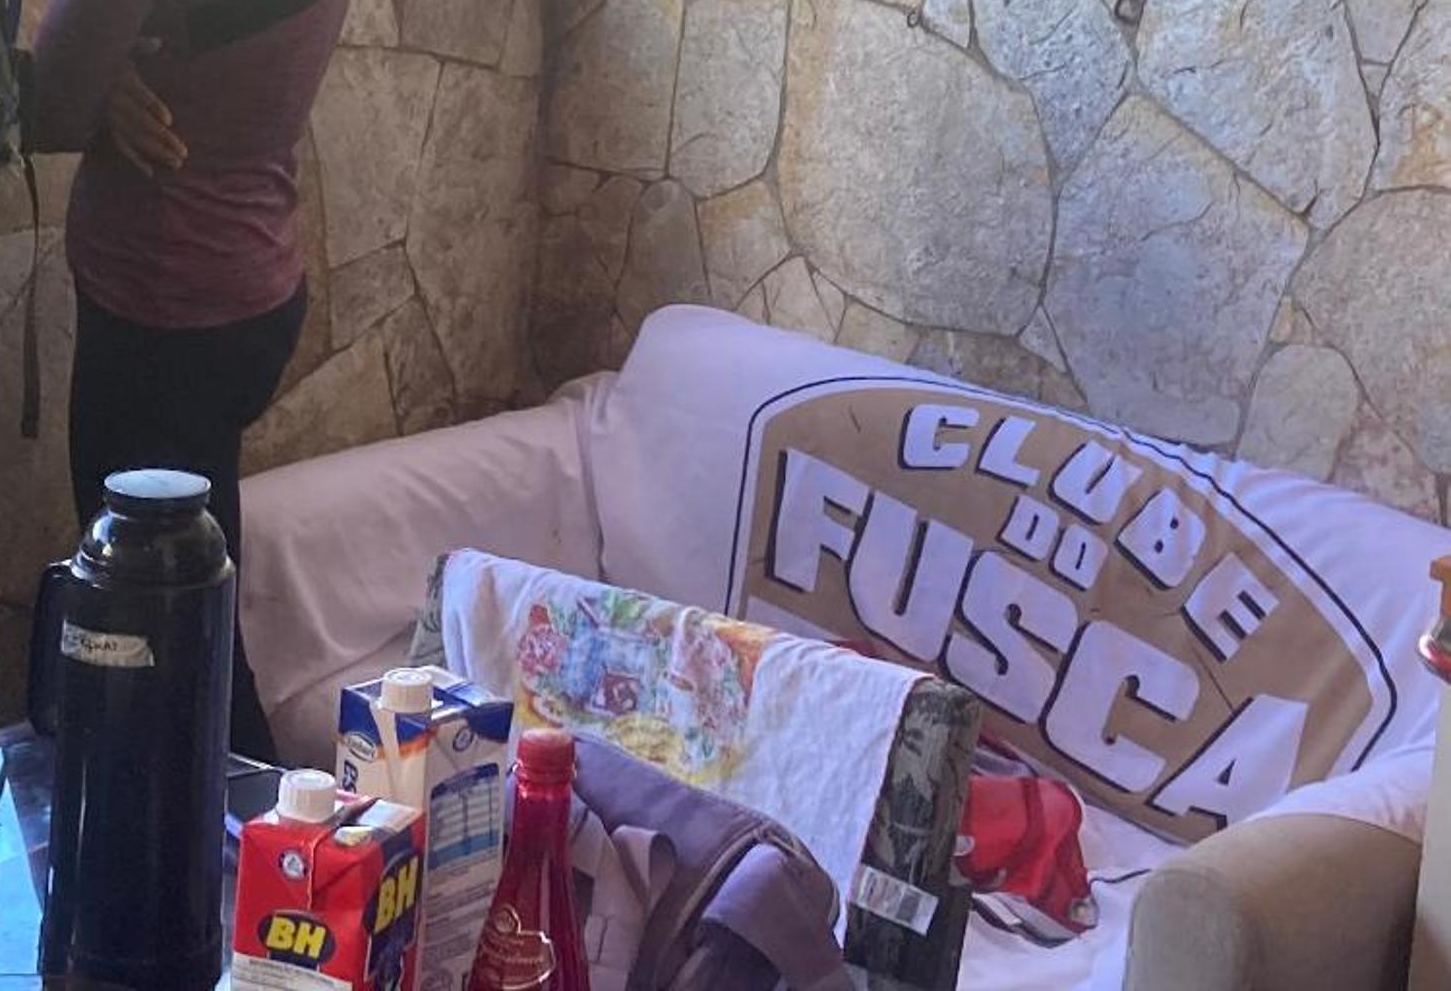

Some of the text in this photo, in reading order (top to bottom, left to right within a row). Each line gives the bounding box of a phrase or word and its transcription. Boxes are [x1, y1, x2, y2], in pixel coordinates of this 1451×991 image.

[899, 403, 1281, 663] CLUBE
[995, 494, 1109, 592] DO
[765, 448, 1310, 830] FUSCA
[266, 914, 327, 960] BH
[373, 855, 419, 935] BH
